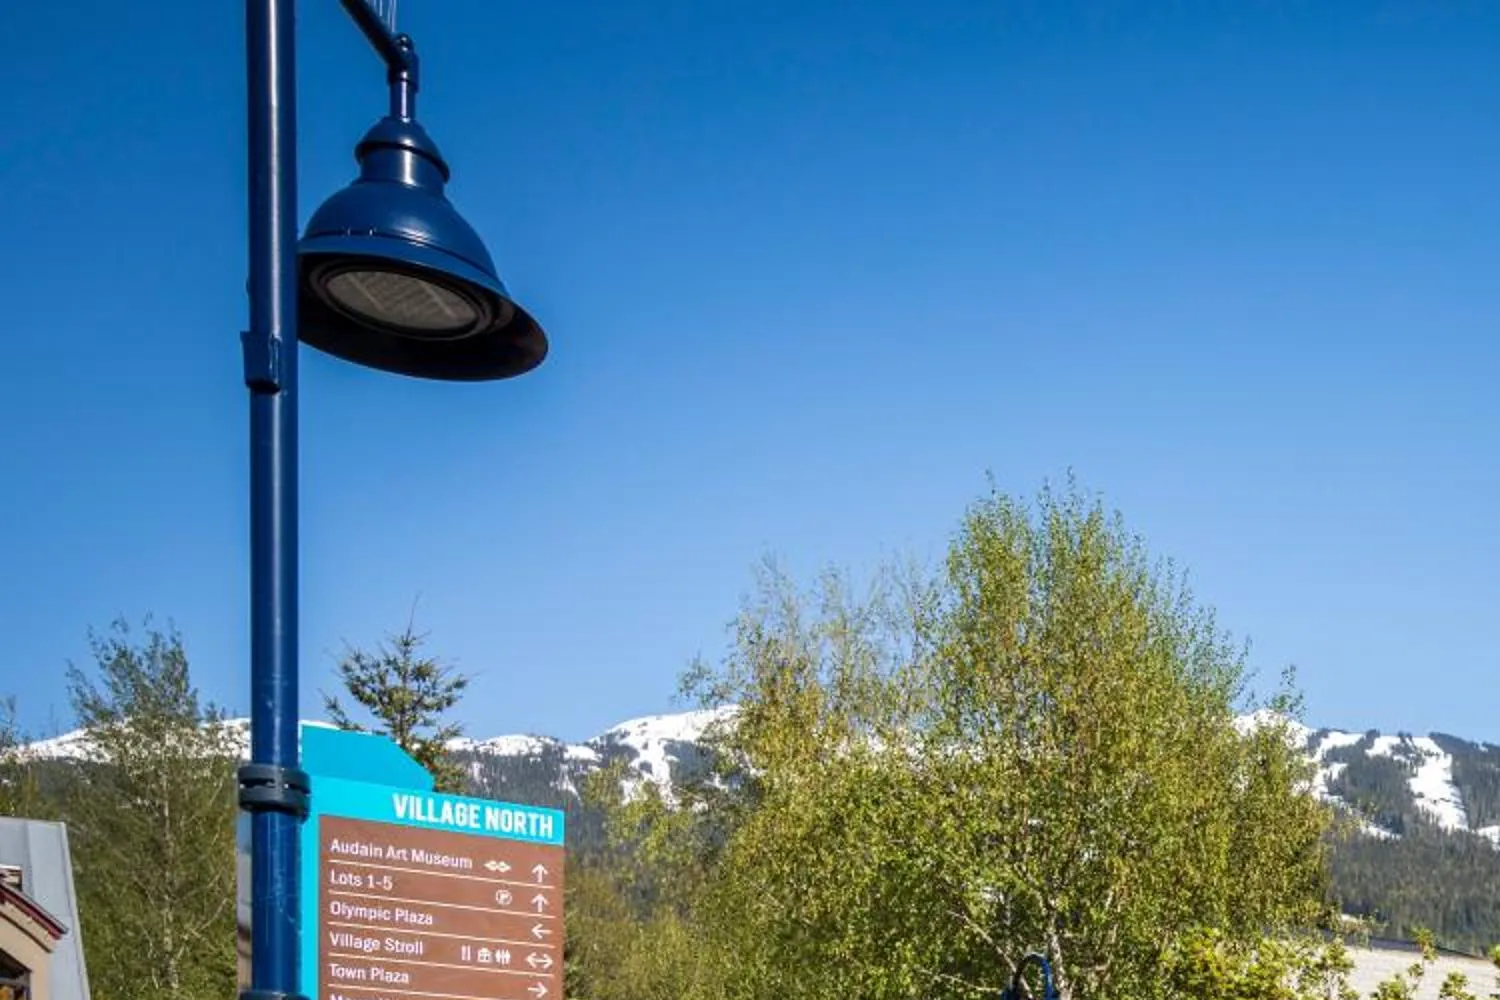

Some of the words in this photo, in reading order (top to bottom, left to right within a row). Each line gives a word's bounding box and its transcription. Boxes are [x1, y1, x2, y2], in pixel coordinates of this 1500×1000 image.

[392, 793, 481, 829] VILLAGE
[485, 807, 553, 839] NORTH
[330, 838, 383, 859] Audain
[385, 845, 409, 862] Art
[411, 848, 473, 869] Museum
[330, 869, 363, 887] Lots
[367, 874, 393, 891] 1-5
[330, 900, 391, 921] Olympic
[394, 908, 433, 925] Plaza
[329, 931, 380, 953] Village
[384, 938, 423, 955] Stroll
[329, 963, 366, 980] Town
[370, 967, 410, 984] Plaza
